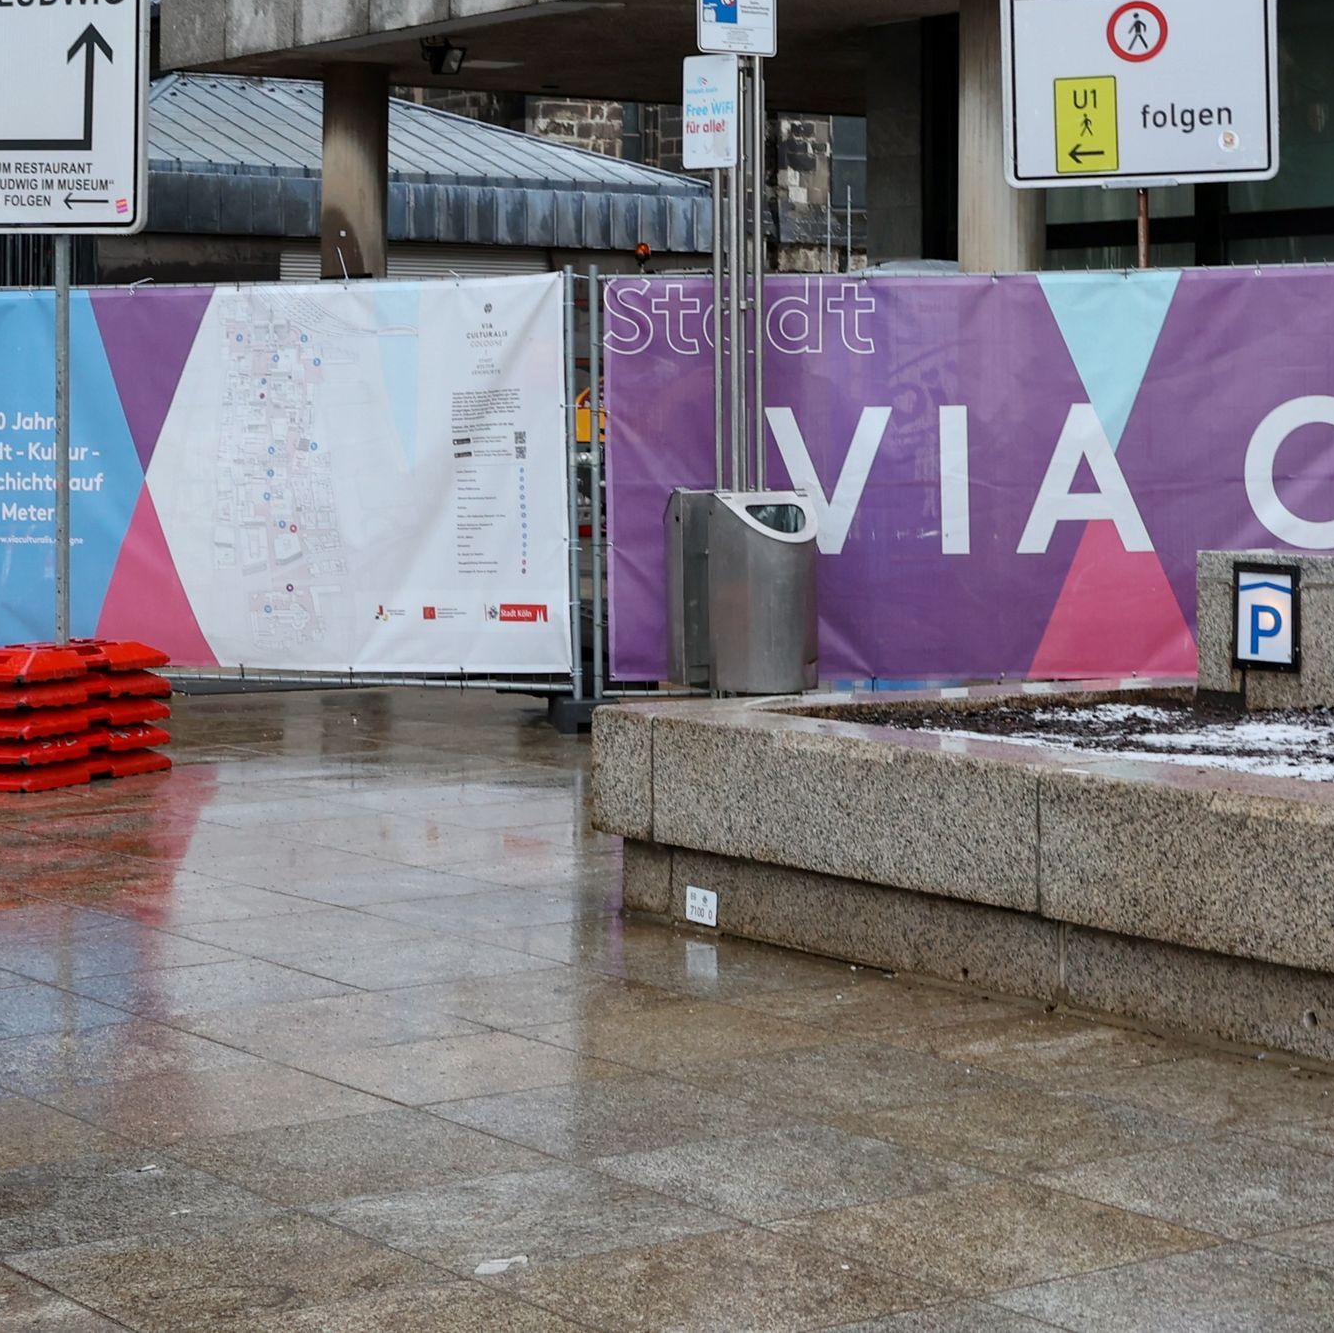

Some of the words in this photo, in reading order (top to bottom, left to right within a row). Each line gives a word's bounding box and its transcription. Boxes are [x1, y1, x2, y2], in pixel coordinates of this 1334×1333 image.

[1072, 88, 1098, 109] U1
[686, 104, 708, 117] Free
[1140, 103, 1233, 134] folgen
[686, 121, 700, 134] für
[702, 118, 726, 133] alle!
[14, 162, 93, 174] RESTAURANT
[41, 179, 54, 190] IM
[4, 195, 52, 206] FOLGEN
[466, 330, 508, 340] CULTURALIS
[28, 442, 88, 461] Kulur
[69, 472, 104, 491] auf
[765, 403, 1155, 555] VIA
[1, 503, 55, 522] Meter
[500, 608, 517, 618] Stadt
[517, 608, 533, 618] Köln
[1250, 603, 1282, 656] P
